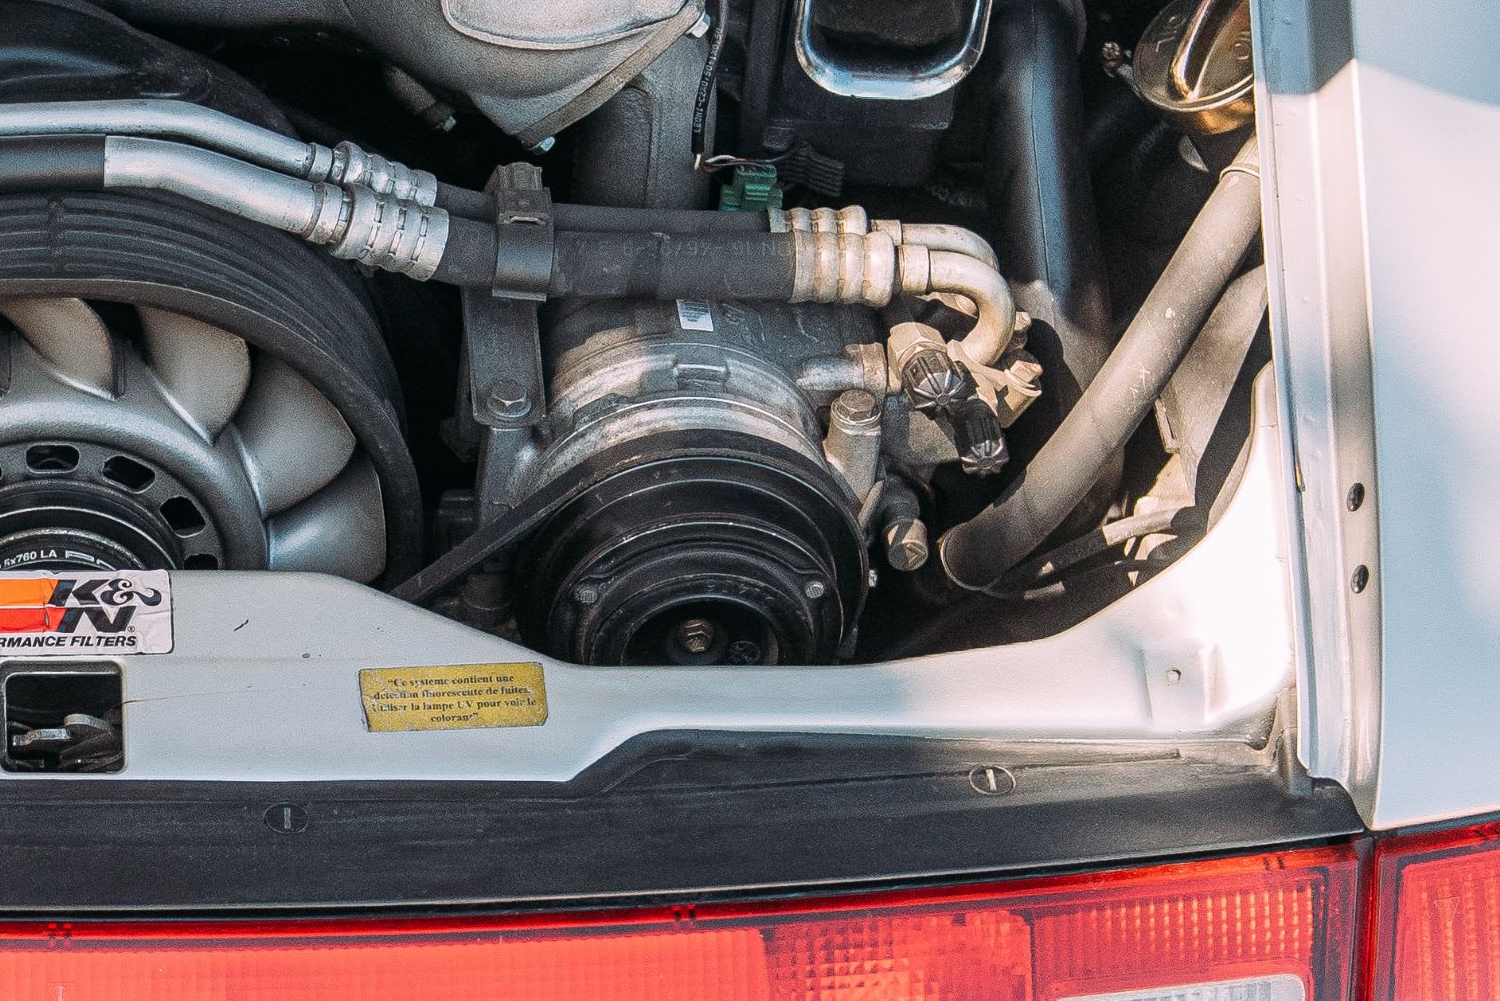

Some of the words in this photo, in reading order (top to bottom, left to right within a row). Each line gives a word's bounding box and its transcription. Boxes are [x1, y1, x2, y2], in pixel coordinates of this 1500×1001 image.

[40, 549, 57, 558] LA
[70, 636, 137, 647] FILTERS
[451, 677, 493, 685] contient
[411, 703, 420, 711] la
[423, 702, 453, 712] lampe
[477, 702, 500, 710] pour
